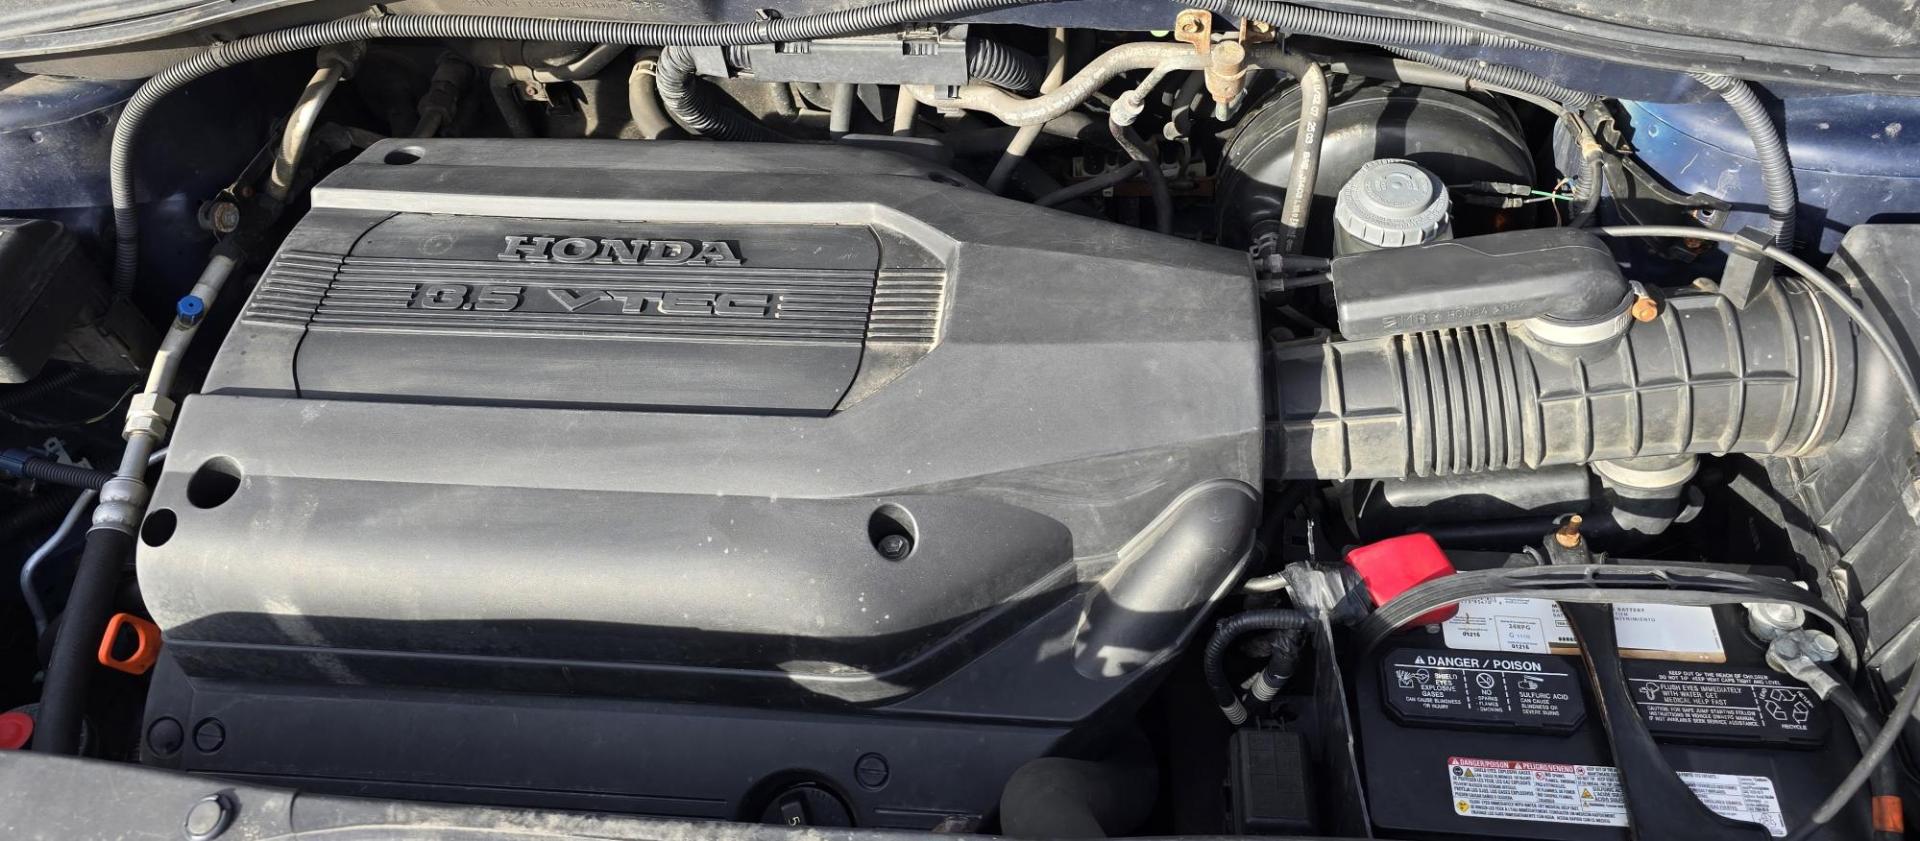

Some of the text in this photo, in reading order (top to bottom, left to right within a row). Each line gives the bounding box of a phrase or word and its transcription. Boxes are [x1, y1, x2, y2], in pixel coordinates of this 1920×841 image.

[1310, 106, 1319, 117] 07
[498, 235, 744, 266] HONDA
[420, 285, 772, 316] 3.5 VTEC
[1428, 656, 1541, 671] DANGER / POISON
[1434, 672, 1458, 680] SHIELD
[1700, 686, 1742, 694] IMMEDIATELY
[1519, 691, 1551, 700] SULFURIC
[1460, 759, 1509, 769] DANGER/POISON
[1523, 763, 1573, 773] PELIGRO/VENENO
[788, 816, 800, 827] 5
